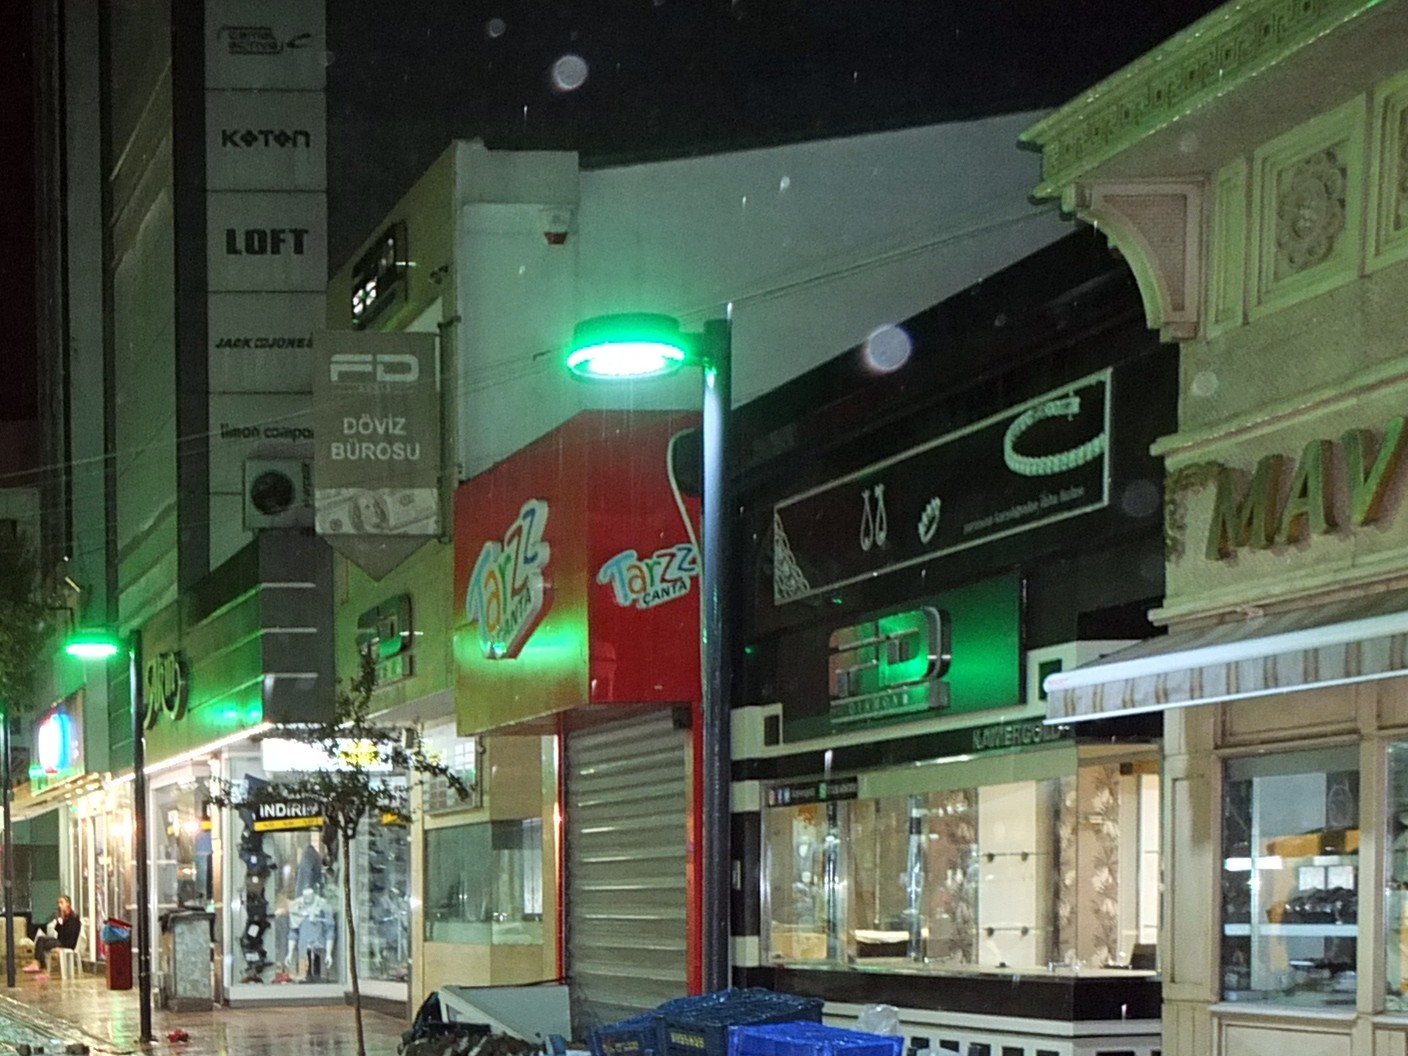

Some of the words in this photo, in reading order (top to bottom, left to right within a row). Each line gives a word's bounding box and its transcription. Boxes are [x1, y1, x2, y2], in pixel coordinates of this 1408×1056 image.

[226, 228, 310, 255] LOFT
[215, 337, 252, 349] JACK
[329, 353, 420, 382] FD
[263, 426, 314, 442] compa
[343, 412, 407, 435] DÖVİZ
[330, 438, 421, 461] BÜROSU
[598, 545, 697, 604] Tarzz
[642, 580, 688, 606] ÇANTA
